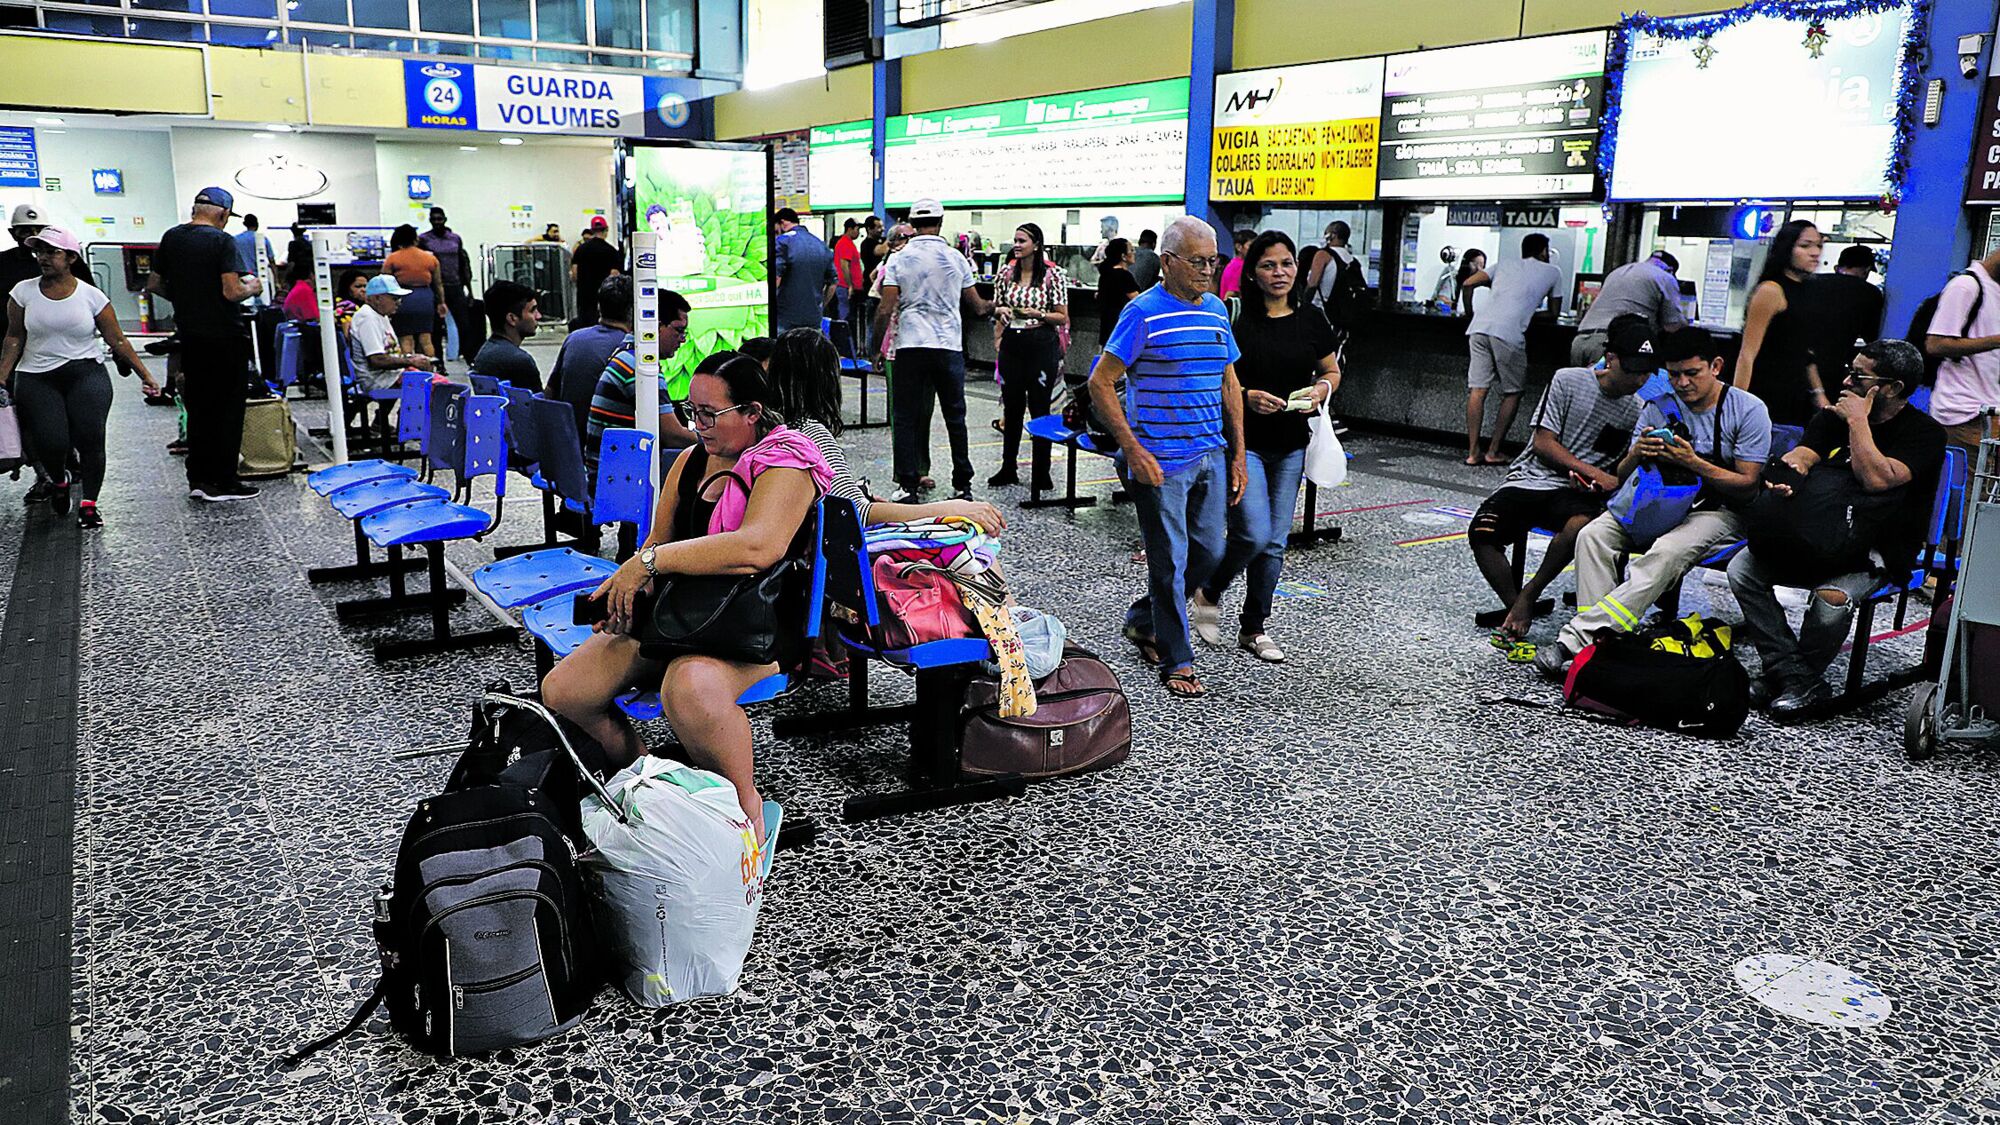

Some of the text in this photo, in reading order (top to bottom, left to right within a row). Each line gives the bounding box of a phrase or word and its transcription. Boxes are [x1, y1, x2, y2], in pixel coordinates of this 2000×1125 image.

[433, 87, 454, 104] 24
[507, 75, 613, 100] GUARDA
[421, 114, 467, 126] HORAS
[498, 103, 620, 129] VOLUMES
[1219, 130, 1259, 150] VIGIA
[1348, 123, 1374, 144] LONGA
[1216, 148, 1373, 173] COLARES BORRALHO MONTE ALEGRE
[1217, 175, 1255, 196] TAUÁ
[1294, 178, 1315, 195] SANTO
[1448, 210, 1498, 225] SANTA IZABEL
[1506, 208, 1555, 226] TAUÁ
